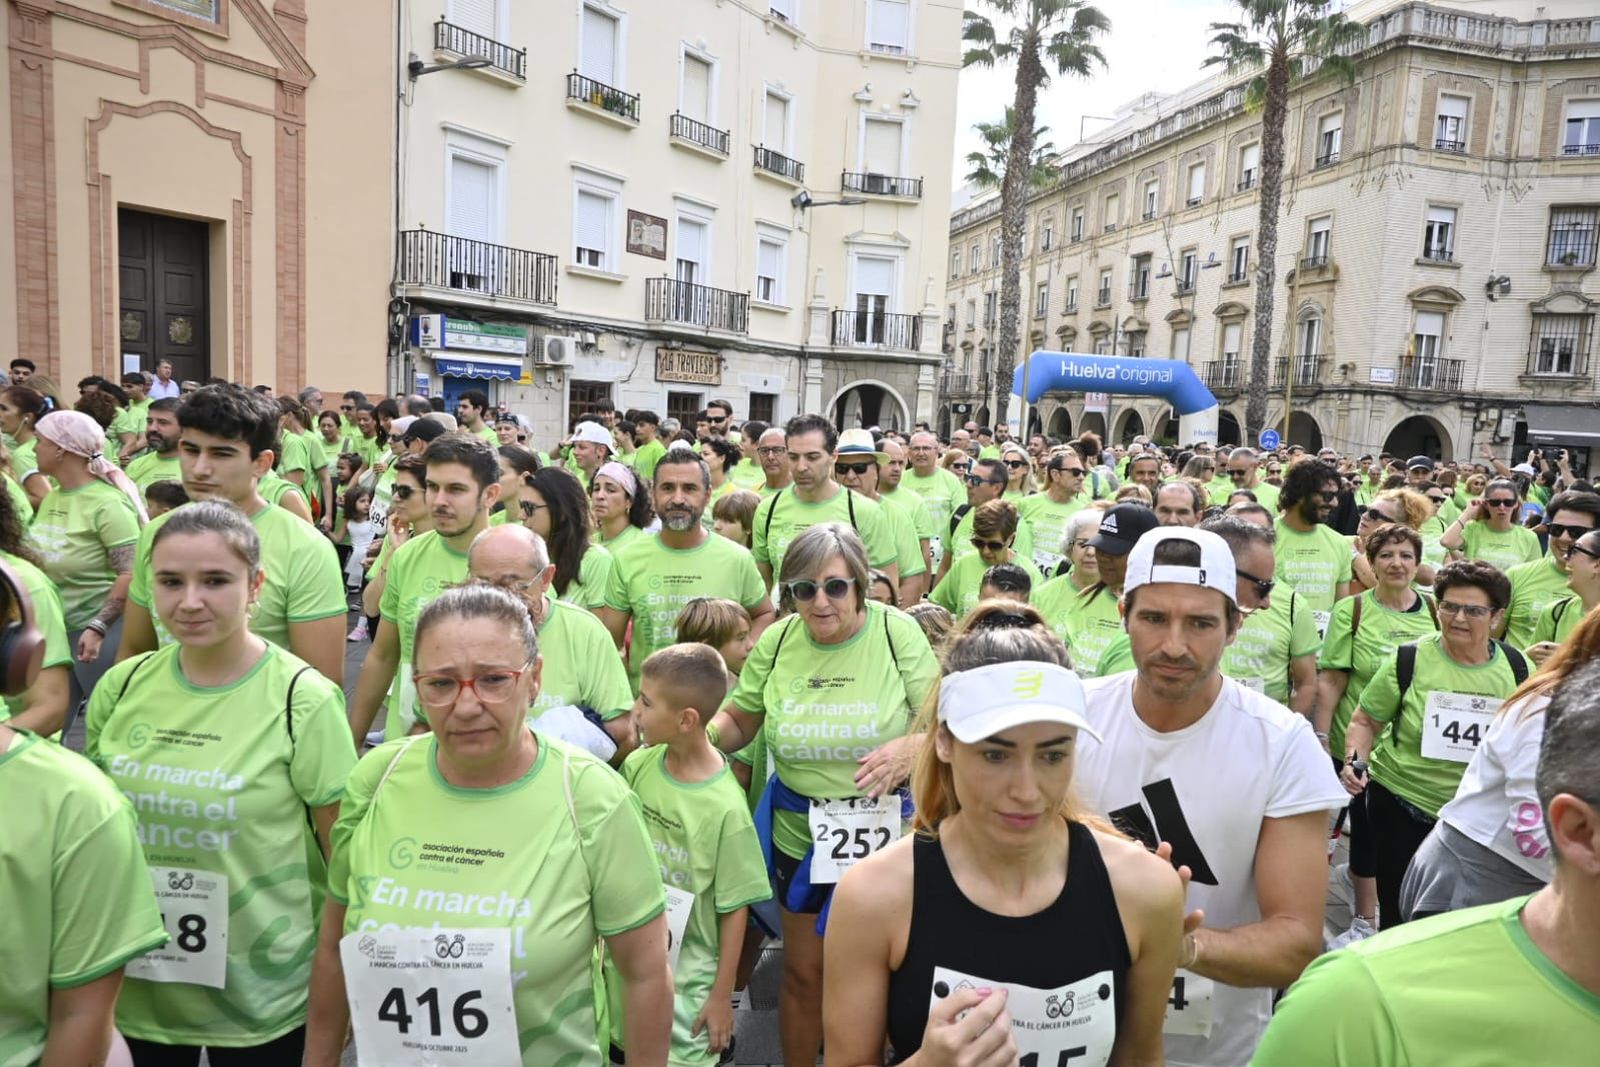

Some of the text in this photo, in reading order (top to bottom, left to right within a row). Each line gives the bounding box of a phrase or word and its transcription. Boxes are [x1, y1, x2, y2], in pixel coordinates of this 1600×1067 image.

[665, 353, 714, 375] LA TRAVIESA
[1061, 361, 1173, 385] Huelva original
[784, 700, 878, 716] En marcha
[779, 720, 880, 738] contra el
[1442, 720, 1490, 746] 44
[111, 754, 244, 791] En marcha
[204, 797, 238, 821] el
[817, 823, 828, 841] 2
[831, 827, 891, 859] 252
[419, 853, 485, 866] contra el cáncer
[422, 843, 505, 858] asociación española
[370, 877, 534, 919] En marcha
[374, 961, 396, 969] MARCHA
[398, 961, 421, 969] CONTRA
[377, 987, 489, 1039] 416
[1026, 1021, 1035, 1030] EL
[1036, 1020, 1060, 1030] CÁNCER
[1062, 1020, 1071, 1028] EN
[1072, 1015, 1092, 1027] HUELVA
